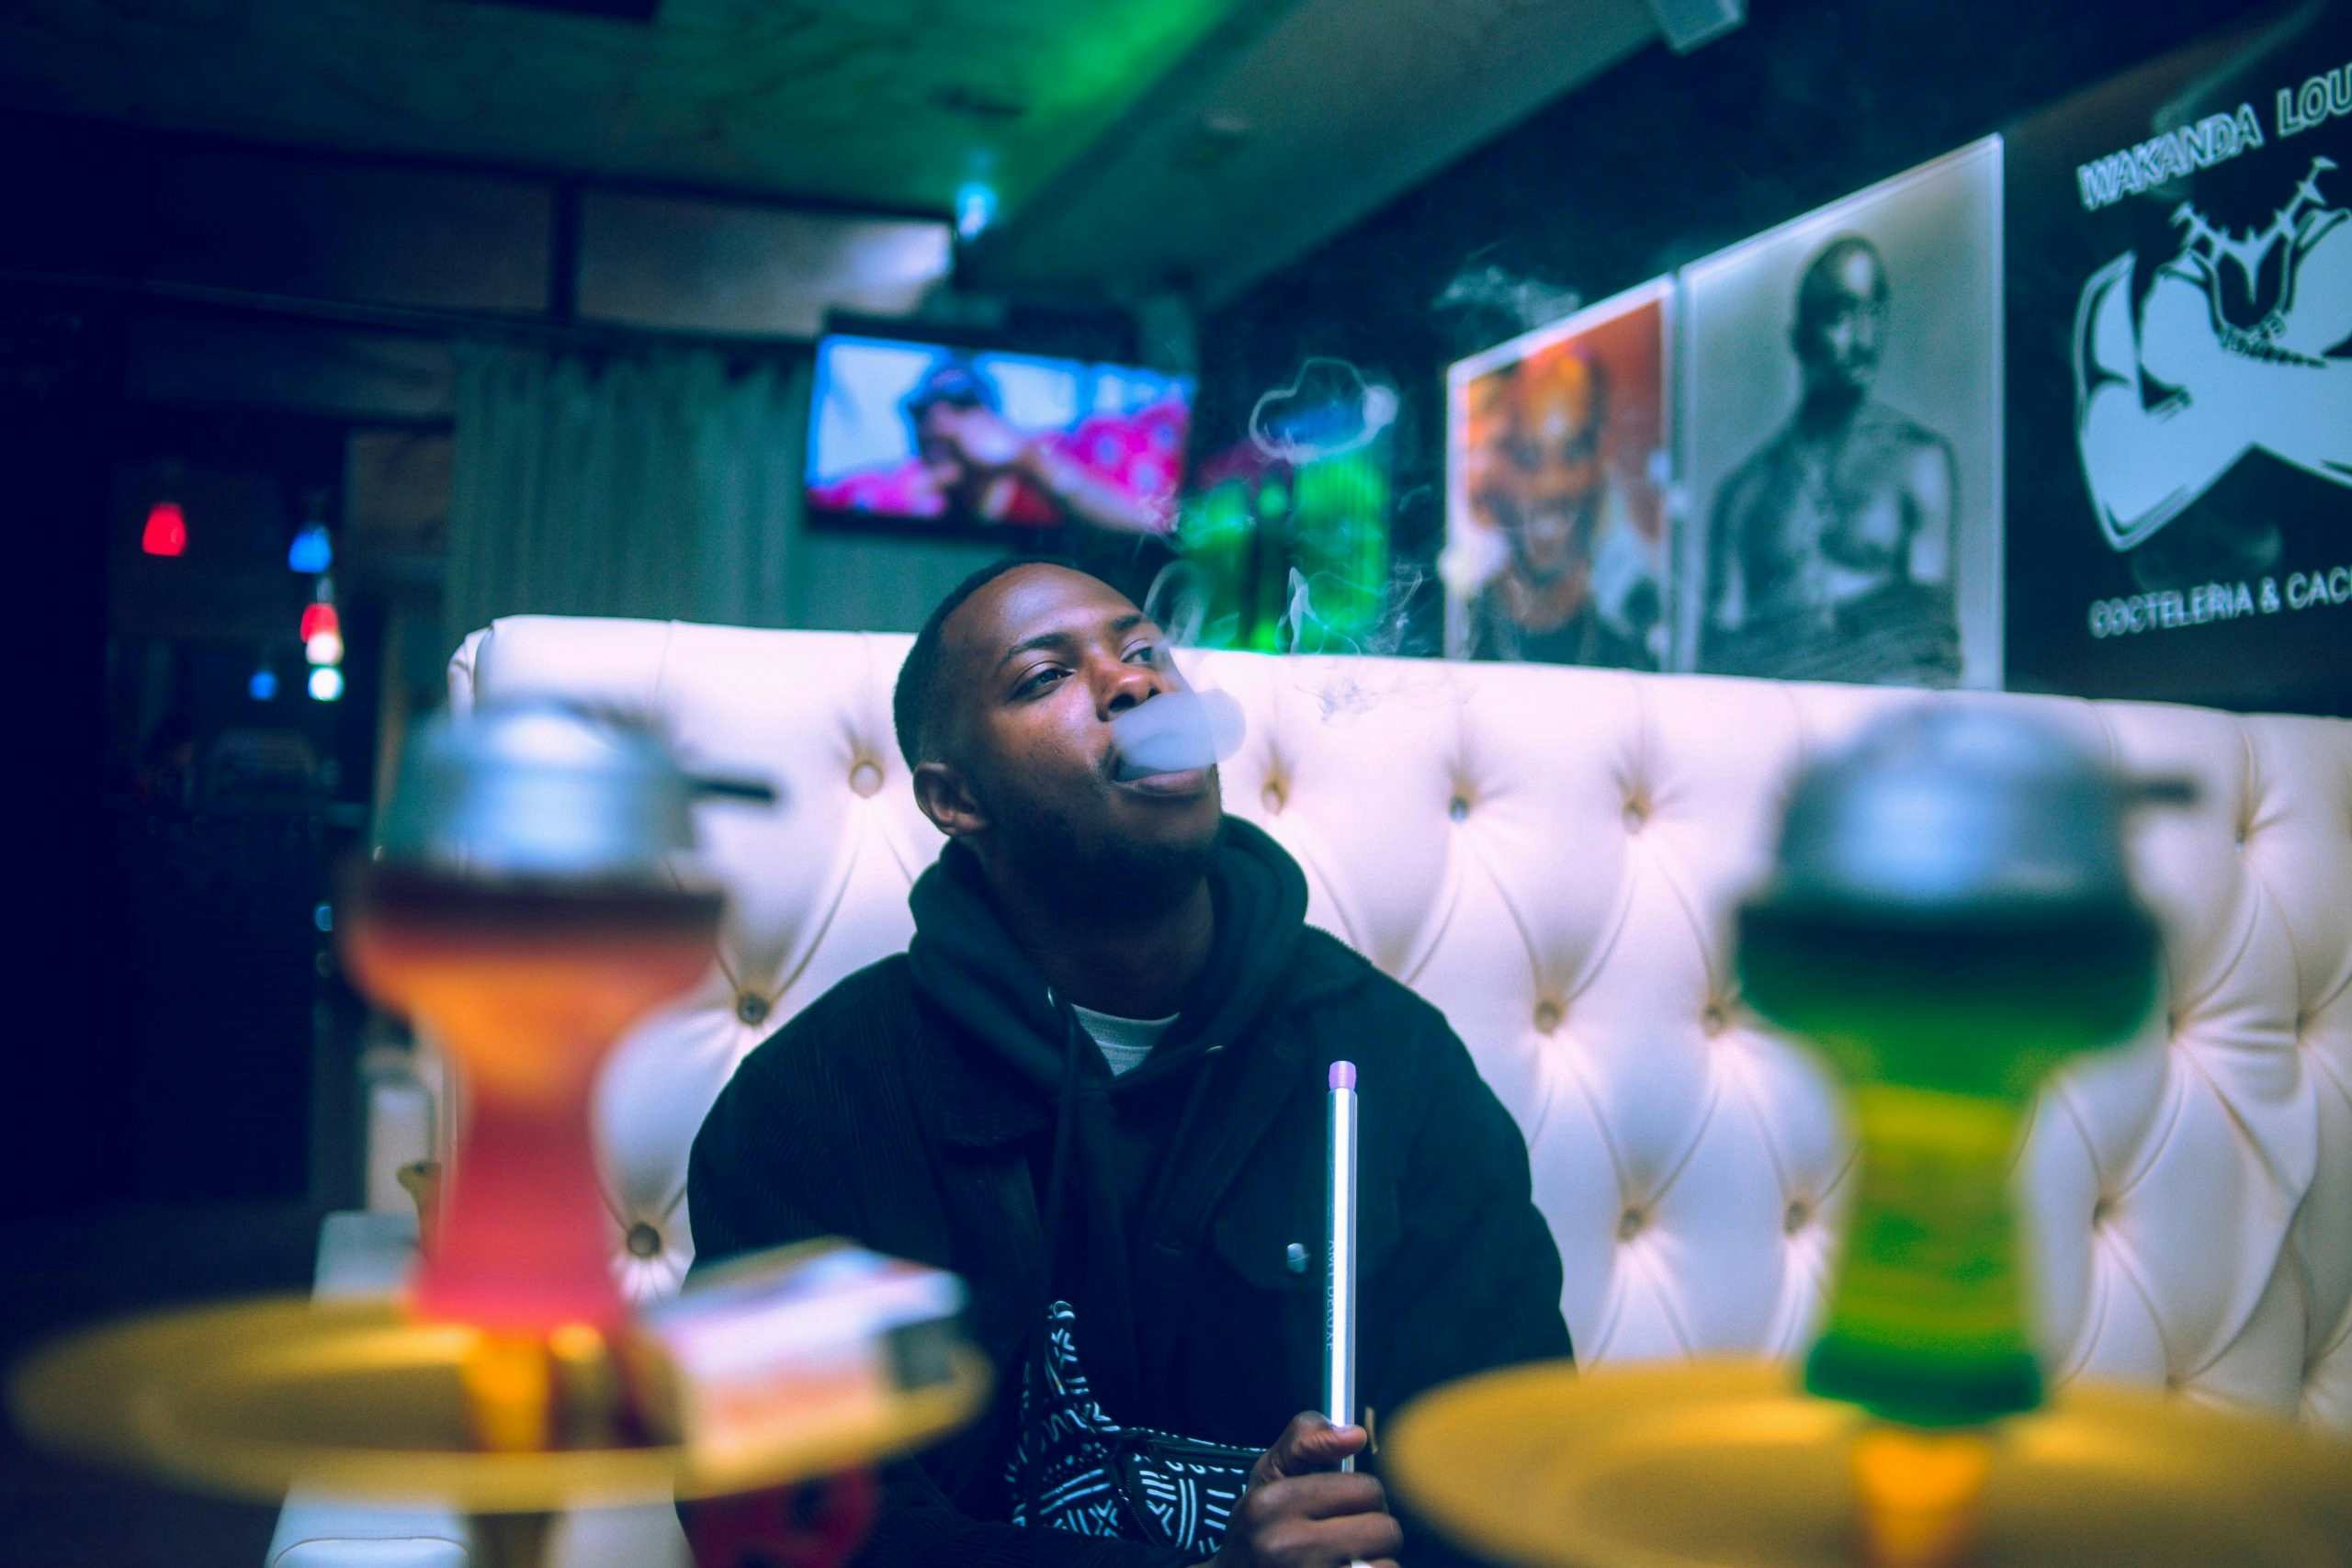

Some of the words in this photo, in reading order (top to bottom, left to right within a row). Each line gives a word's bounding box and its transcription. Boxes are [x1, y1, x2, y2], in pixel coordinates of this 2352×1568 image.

[2076, 103, 2266, 211] WAKANDA
[2260, 576, 2280, 613] &
[2286, 564, 2352, 610] CAC
